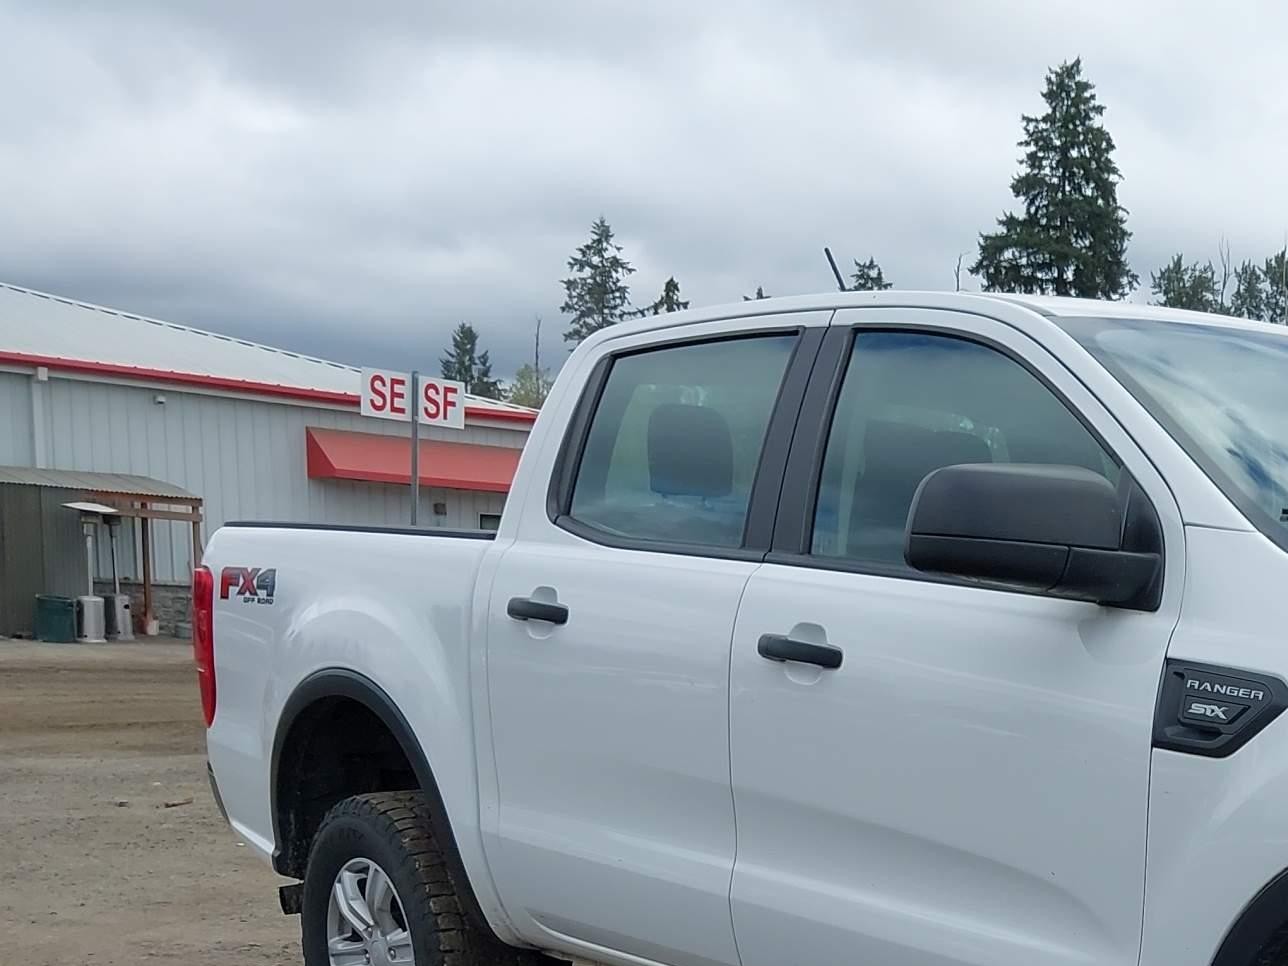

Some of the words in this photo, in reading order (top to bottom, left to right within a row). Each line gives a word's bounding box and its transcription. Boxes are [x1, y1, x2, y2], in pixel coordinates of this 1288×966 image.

[369, 374, 406, 415] SE
[423, 383, 458, 421] SF
[220, 566, 277, 600] FX4
[1187, 679, 1264, 701] RANGER
[1187, 703, 1229, 720] STX
